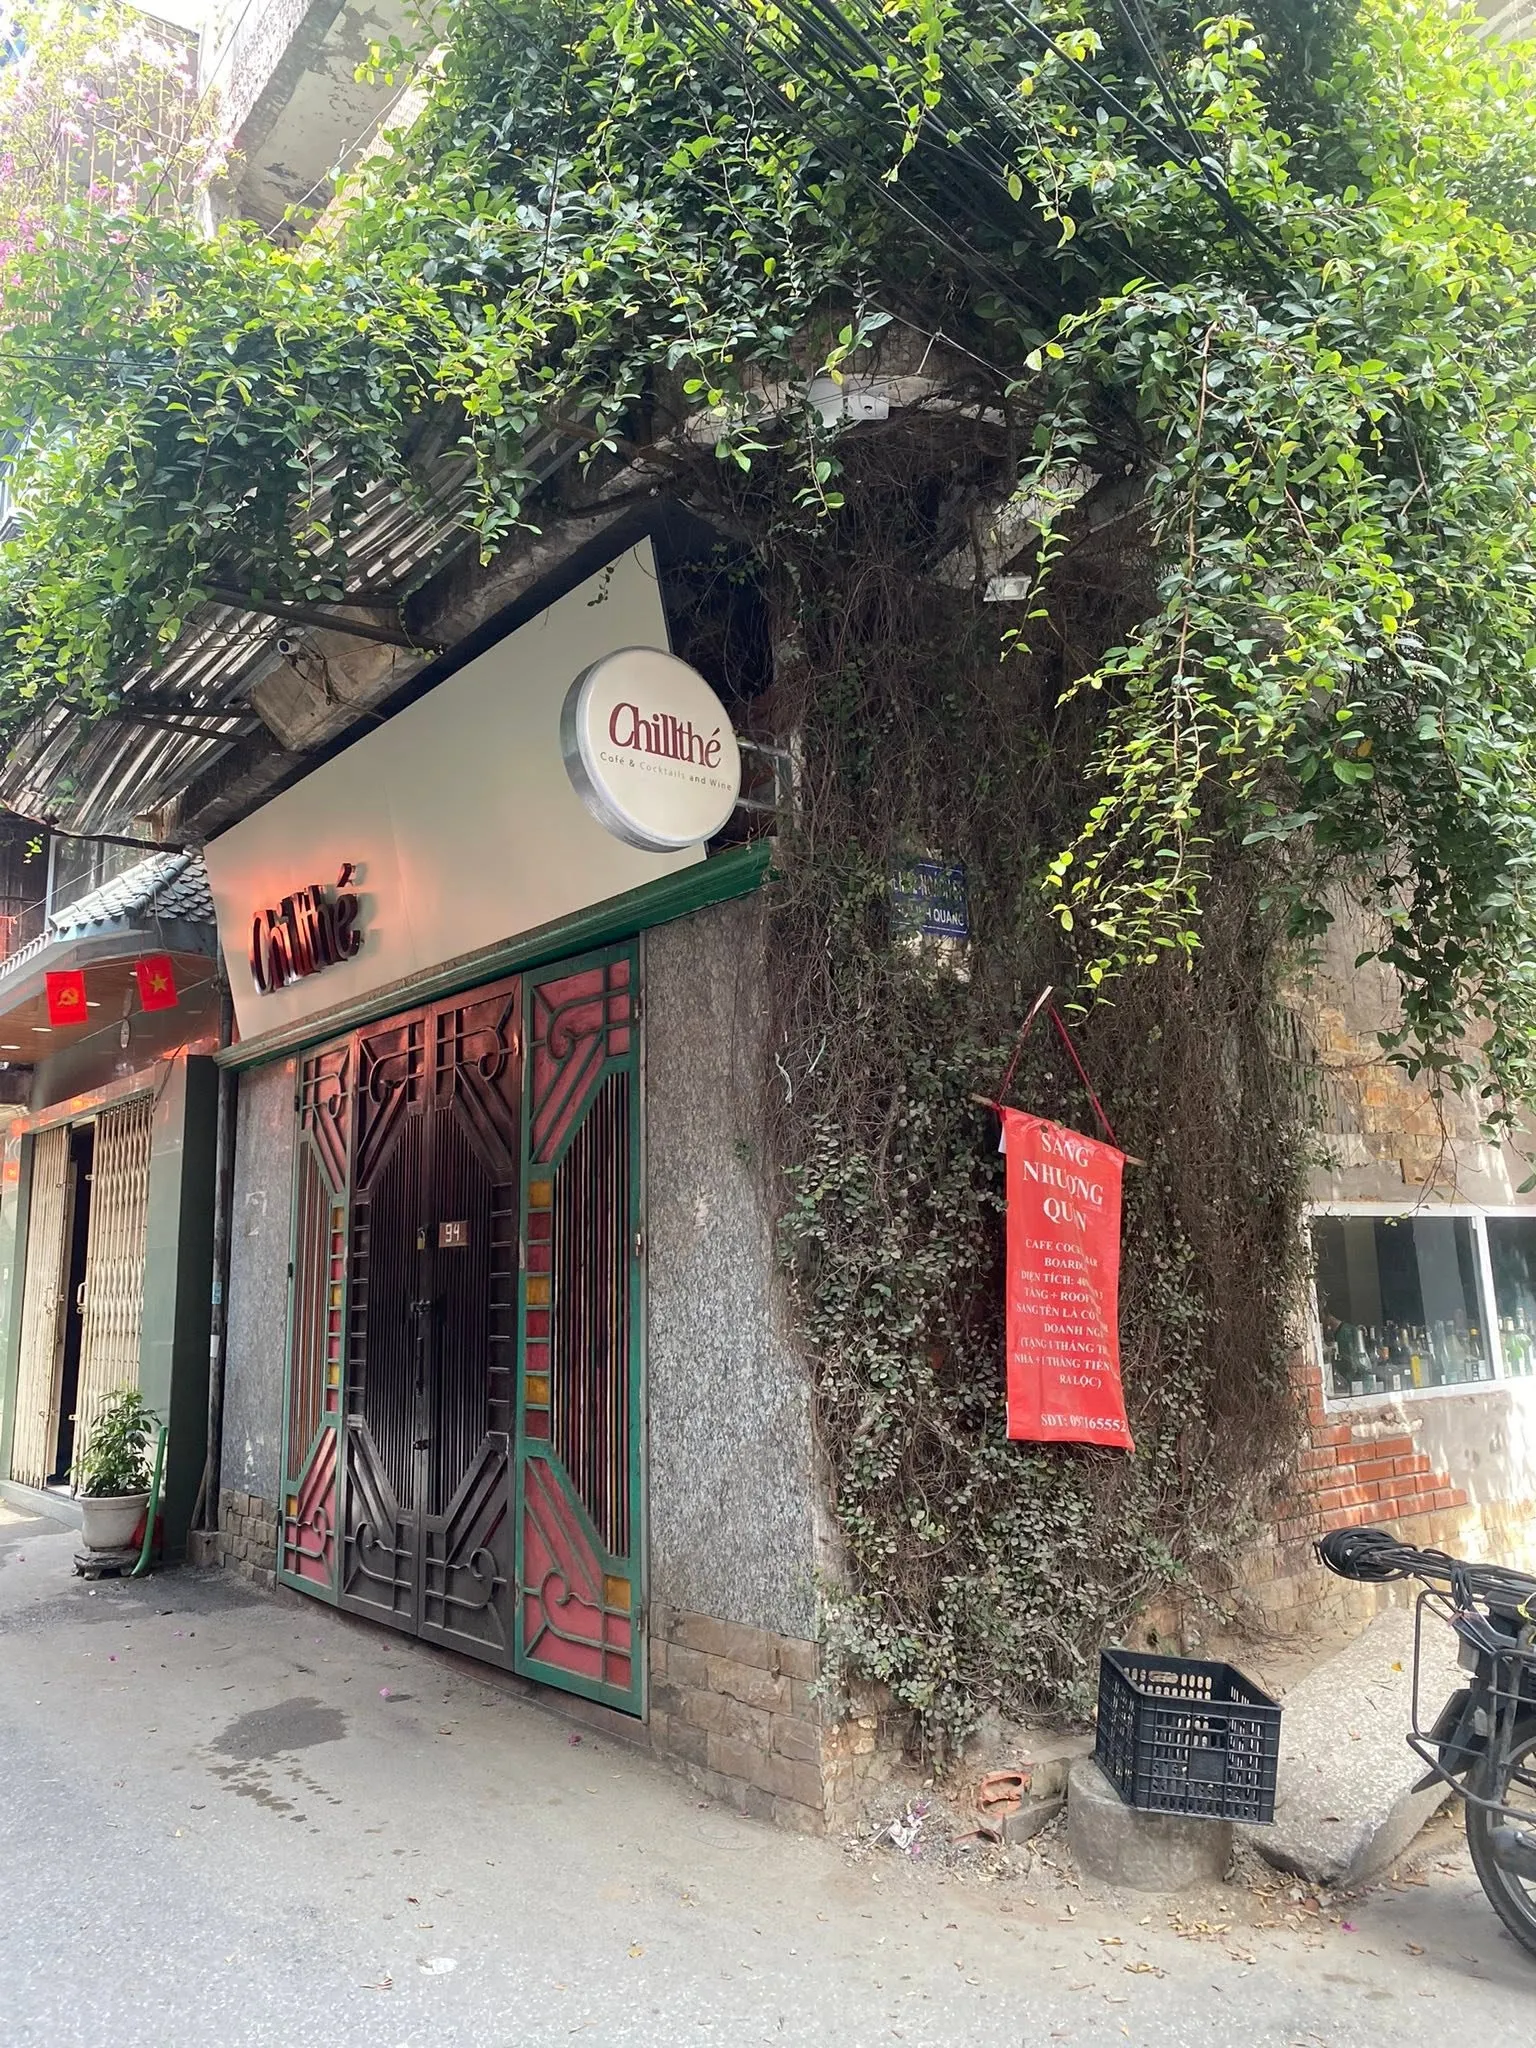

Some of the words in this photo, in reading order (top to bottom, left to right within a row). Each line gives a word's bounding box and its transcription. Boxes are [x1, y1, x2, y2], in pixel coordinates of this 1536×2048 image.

[609, 702, 722, 769] Chillthé
[600, 752, 625, 765] Café
[629, 760, 635, 768] &
[639, 761, 685, 780] Cocktails
[689, 775, 706, 785] and
[709, 778, 732, 791] Wine
[1042, 1133, 1089, 1167] SANG
[445, 1223, 460, 1242] 94
[1044, 1323, 1083, 1336] DOANH
